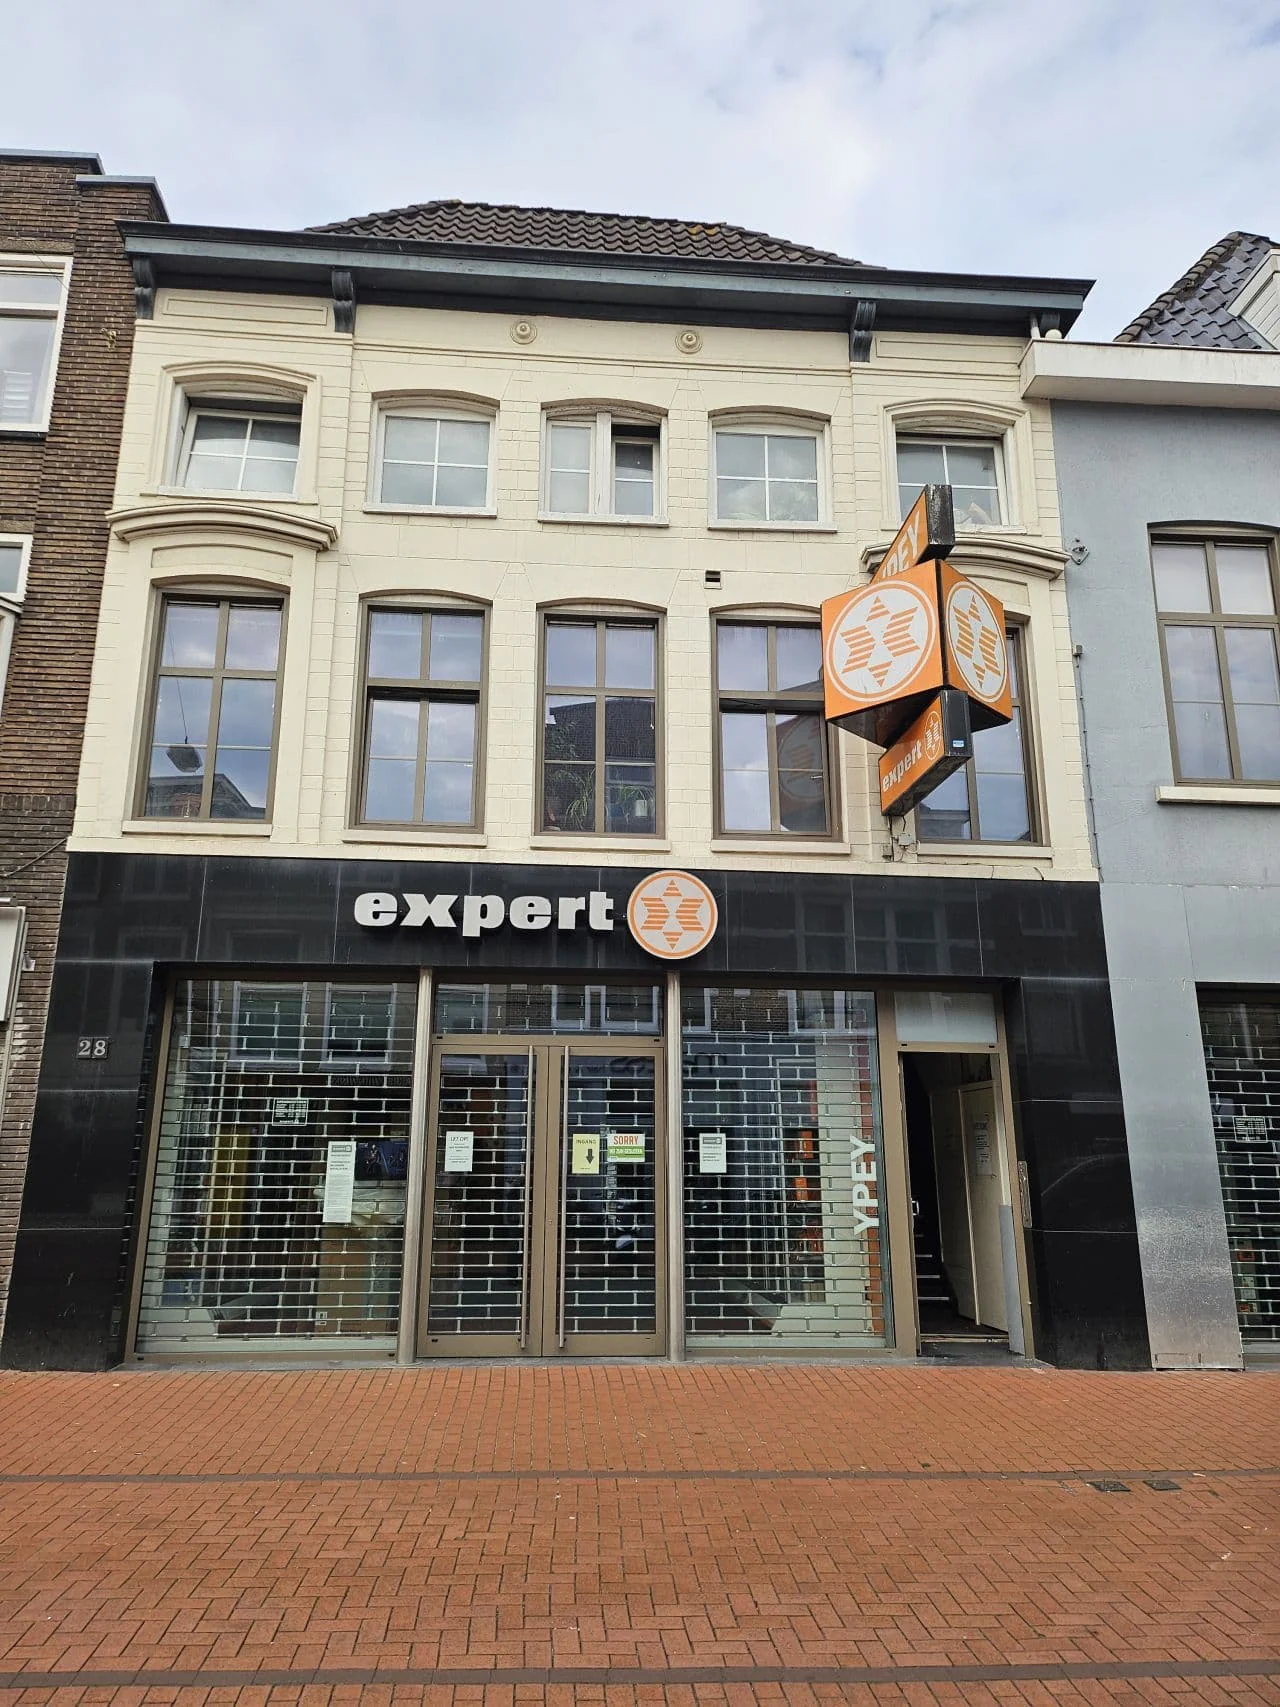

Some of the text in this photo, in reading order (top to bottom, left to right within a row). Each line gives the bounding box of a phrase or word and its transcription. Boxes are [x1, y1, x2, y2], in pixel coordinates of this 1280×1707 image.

[882, 739, 922, 792] expert
[353, 891, 614, 937] expert
[79, 1041, 106, 1056] 28
[613, 1135, 639, 1145] SORRY
[850, 1135, 880, 1236] YPEY
